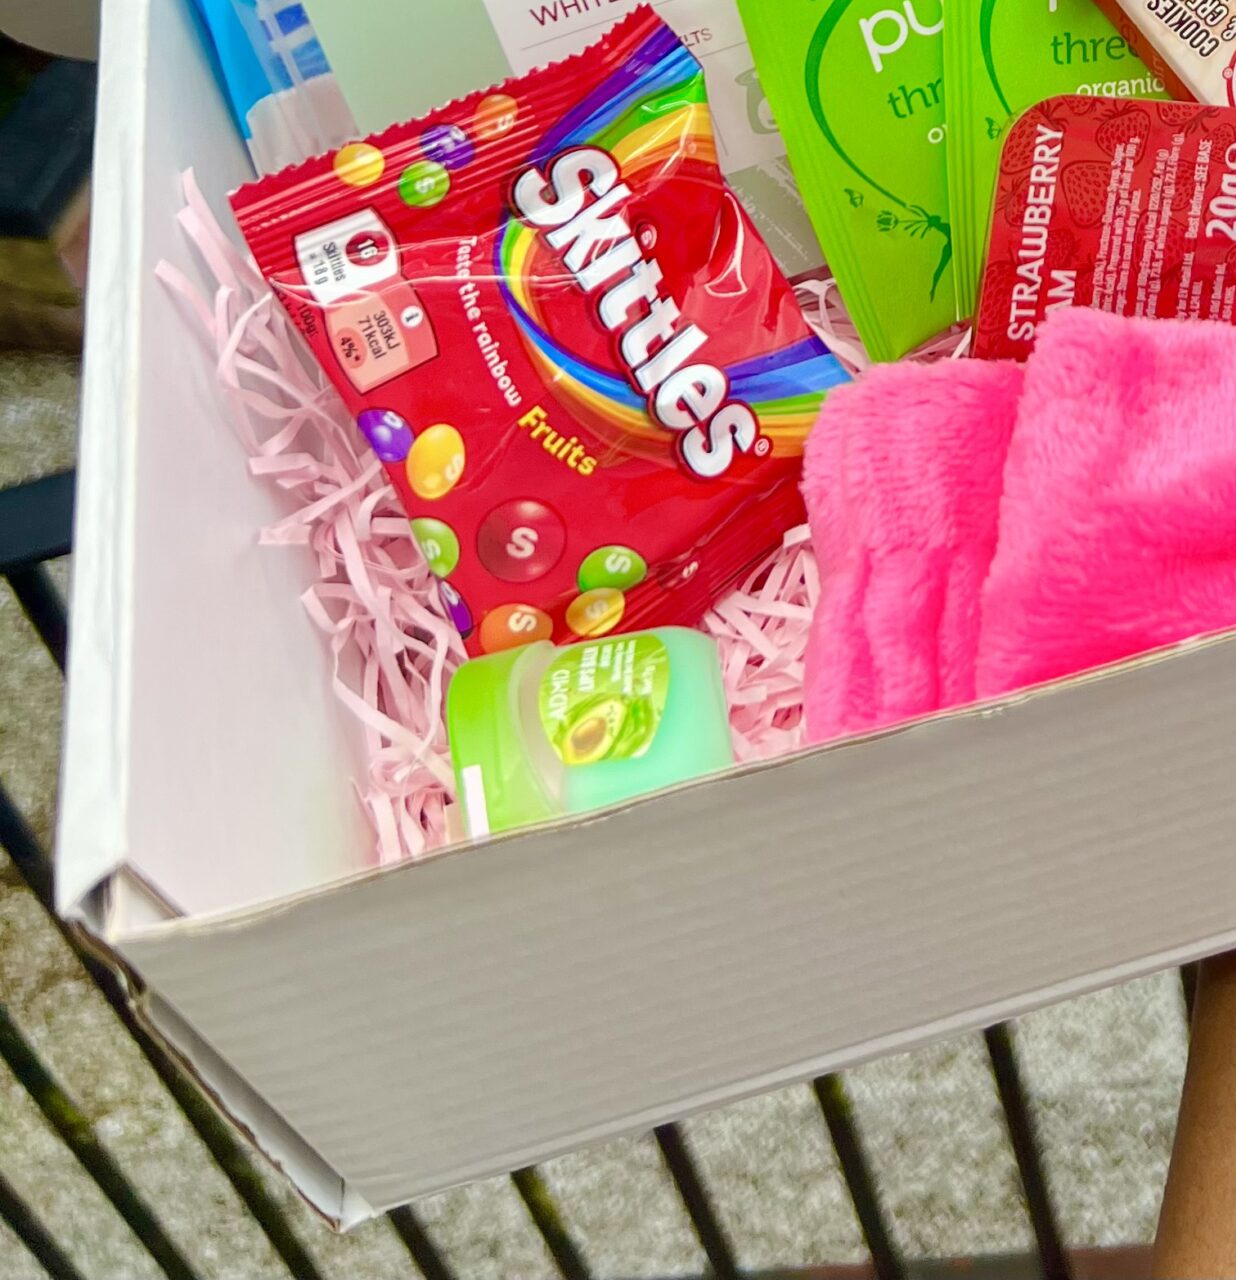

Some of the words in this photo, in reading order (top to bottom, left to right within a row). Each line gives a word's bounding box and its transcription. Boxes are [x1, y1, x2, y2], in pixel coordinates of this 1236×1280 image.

[887, 78, 942, 120] thr
[1193, 163, 1208, 181] SEE
[1196, 138, 1212, 163] BASE
[1007, 123, 1064, 341] STRAWBERRY
[1184, 216, 1199, 238] Best
[321, 242, 347, 282] Skittles
[513, 146, 760, 478] Skittles
[1045, 269, 1077, 314] AM
[354, 315, 389, 360] 71kcal
[368, 308, 402, 351] 303kJ
[456, 280, 482, 321] the
[471, 320, 523, 408] rainbow
[518, 406, 598, 477] Fruits
